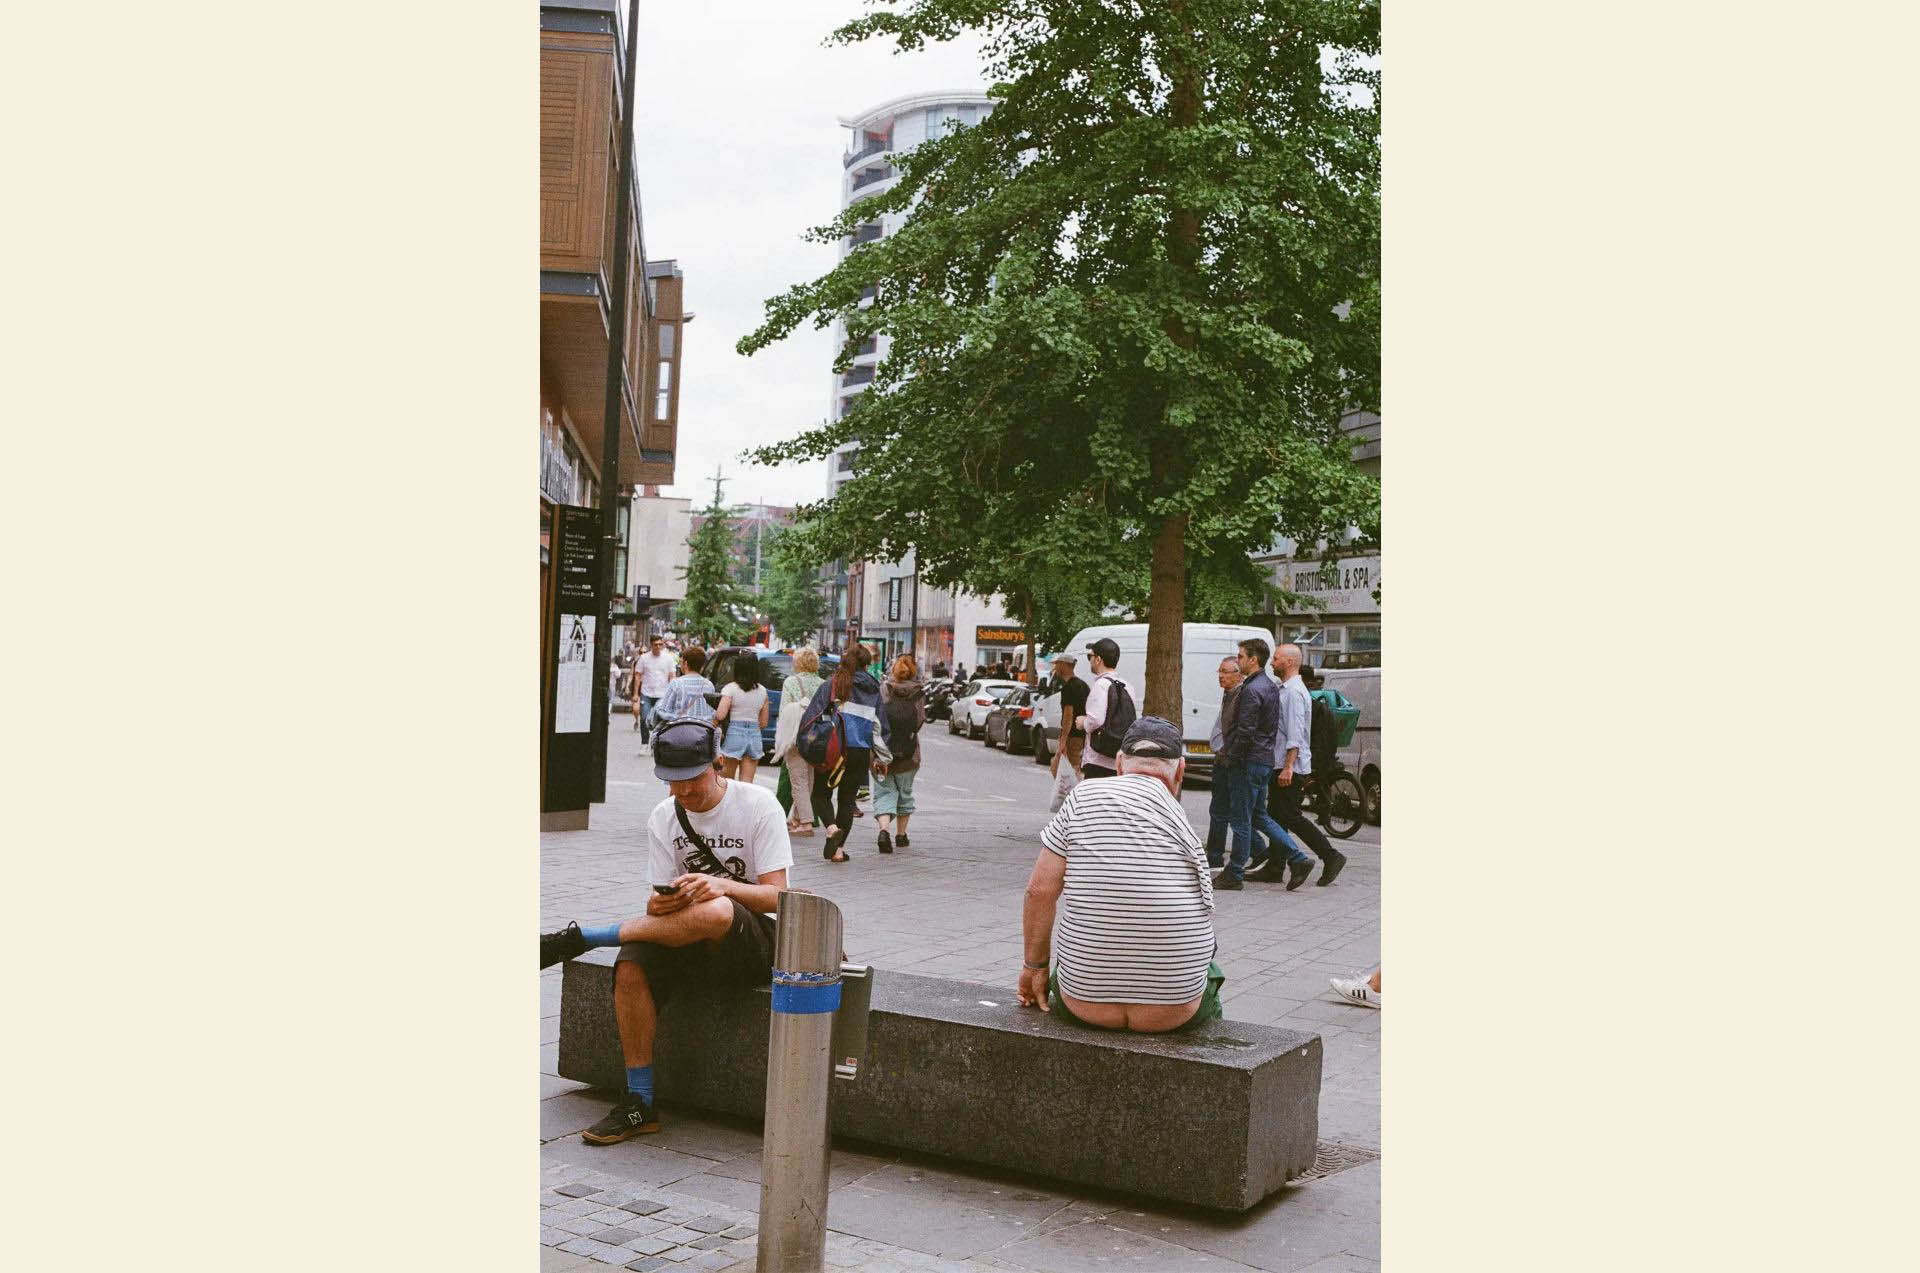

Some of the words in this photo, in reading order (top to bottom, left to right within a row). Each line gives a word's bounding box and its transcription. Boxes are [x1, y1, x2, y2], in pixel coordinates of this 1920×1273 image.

[1295, 570, 1323, 592] BRISTOL
[1344, 569, 1351, 589] &
[1353, 567, 1369, 589] SPA
[978, 629, 1024, 643] Sainsbury's
[672, 834, 744, 850] Tenics
[628, 1111, 642, 1126] N
